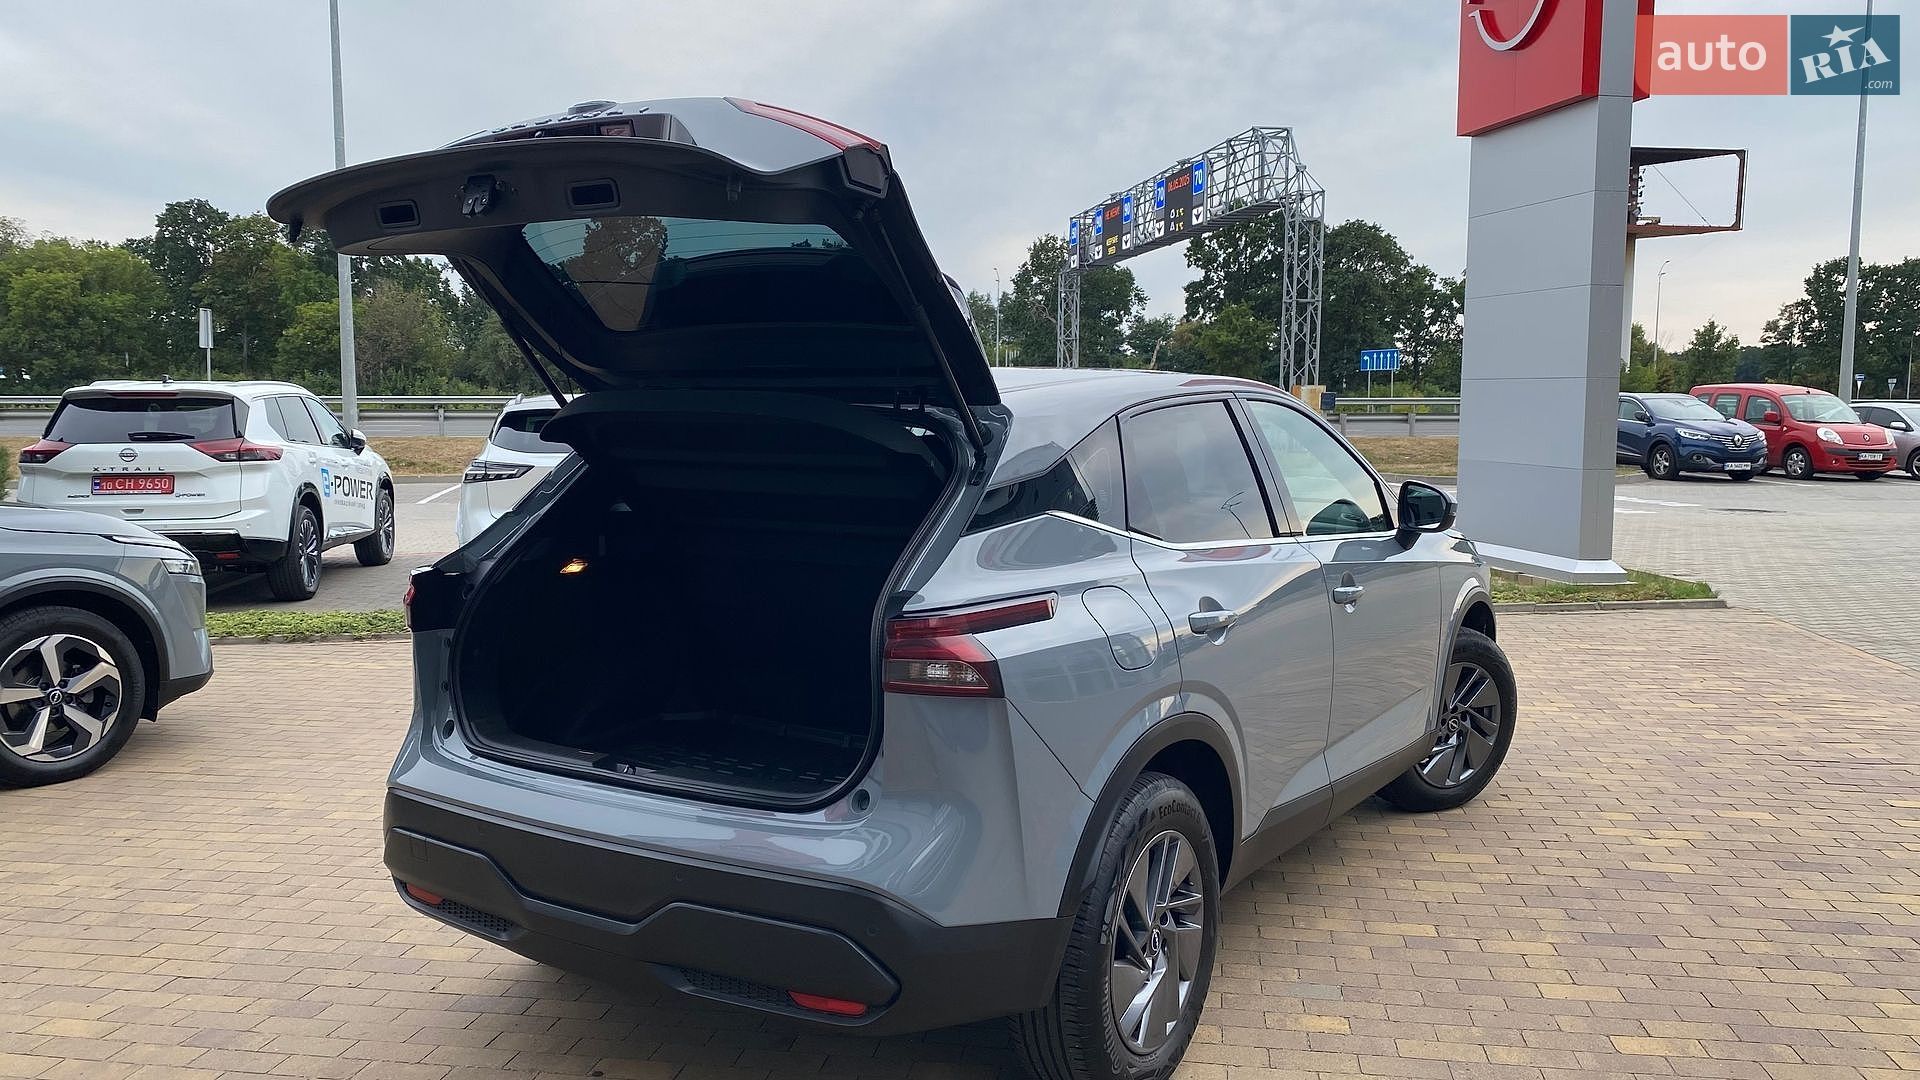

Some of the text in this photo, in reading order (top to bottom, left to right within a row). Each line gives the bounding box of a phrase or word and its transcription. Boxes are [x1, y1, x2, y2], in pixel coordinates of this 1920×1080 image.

[1194, 168, 1203, 186] 70
[102, 478, 169, 490] 10 CH 9650
[321, 468, 373, 500] e-POWER
